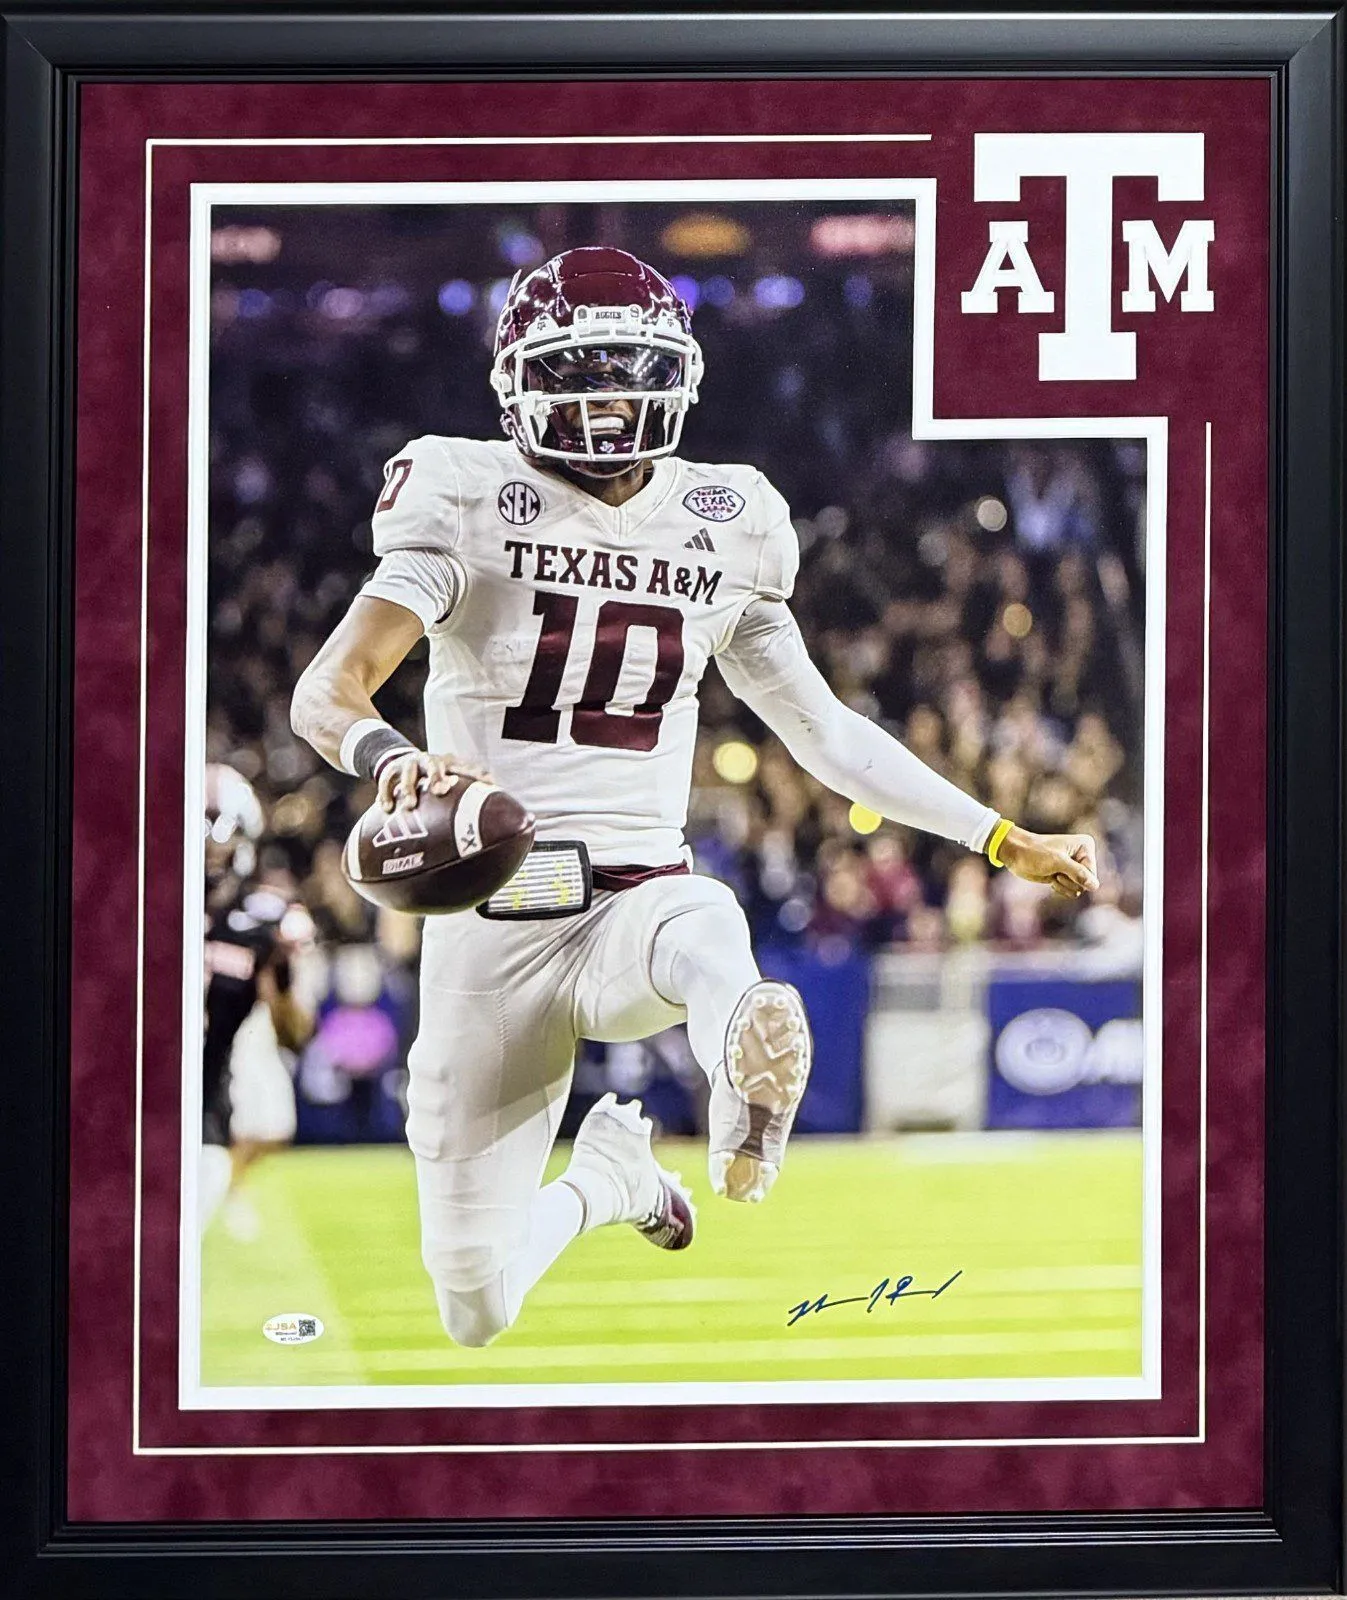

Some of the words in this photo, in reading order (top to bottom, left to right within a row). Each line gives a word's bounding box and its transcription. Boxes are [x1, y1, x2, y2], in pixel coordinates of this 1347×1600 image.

[499, 483, 539, 524] SEC
[692, 495, 736, 508] TEXAS
[504, 540, 638, 591] TEXAS
[646, 559, 723, 605] A&M
[501, 590, 685, 752] 10
